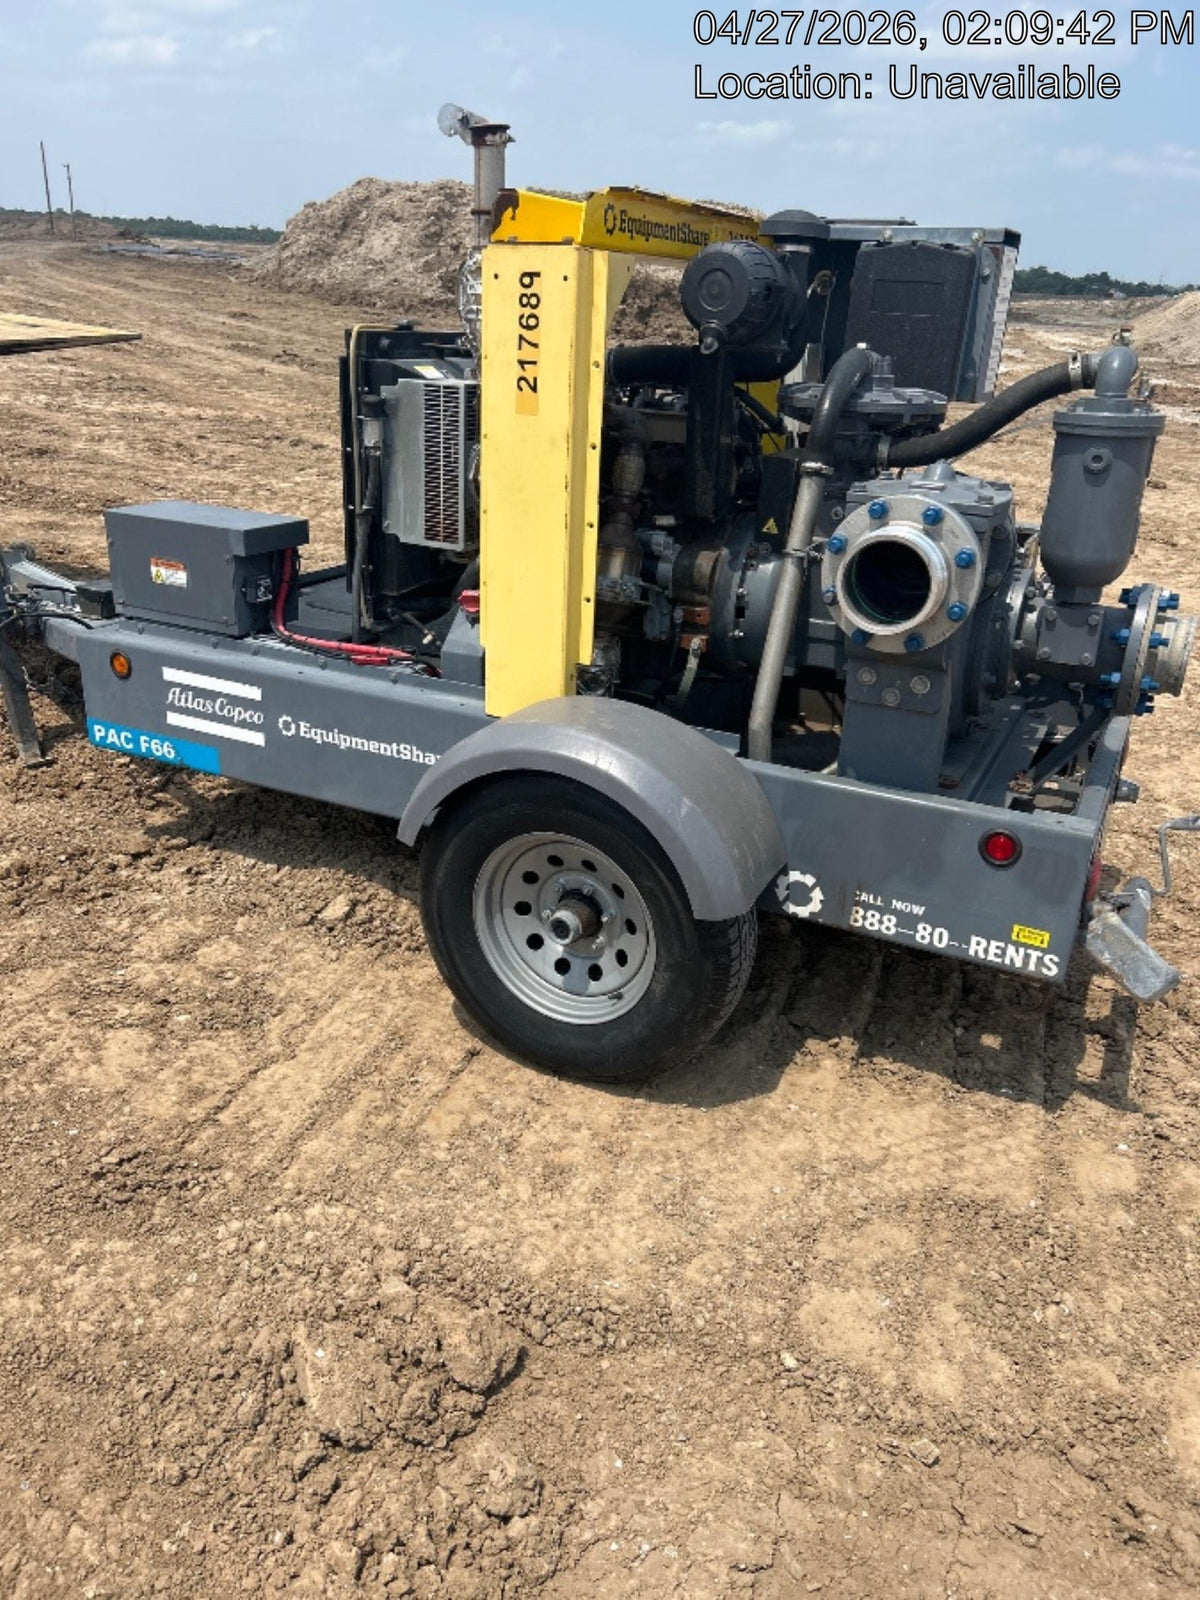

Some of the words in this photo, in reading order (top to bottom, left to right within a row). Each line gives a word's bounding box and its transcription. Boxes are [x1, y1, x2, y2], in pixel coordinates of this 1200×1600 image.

[618, 209, 710, 246] EquipmentShare
[517, 271, 541, 393] 217689
[94, 724, 134, 749] PAC
[140, 735, 175, 759] F66
[298, 721, 442, 766] EquipmentSha
[891, 899, 925, 916] NOW
